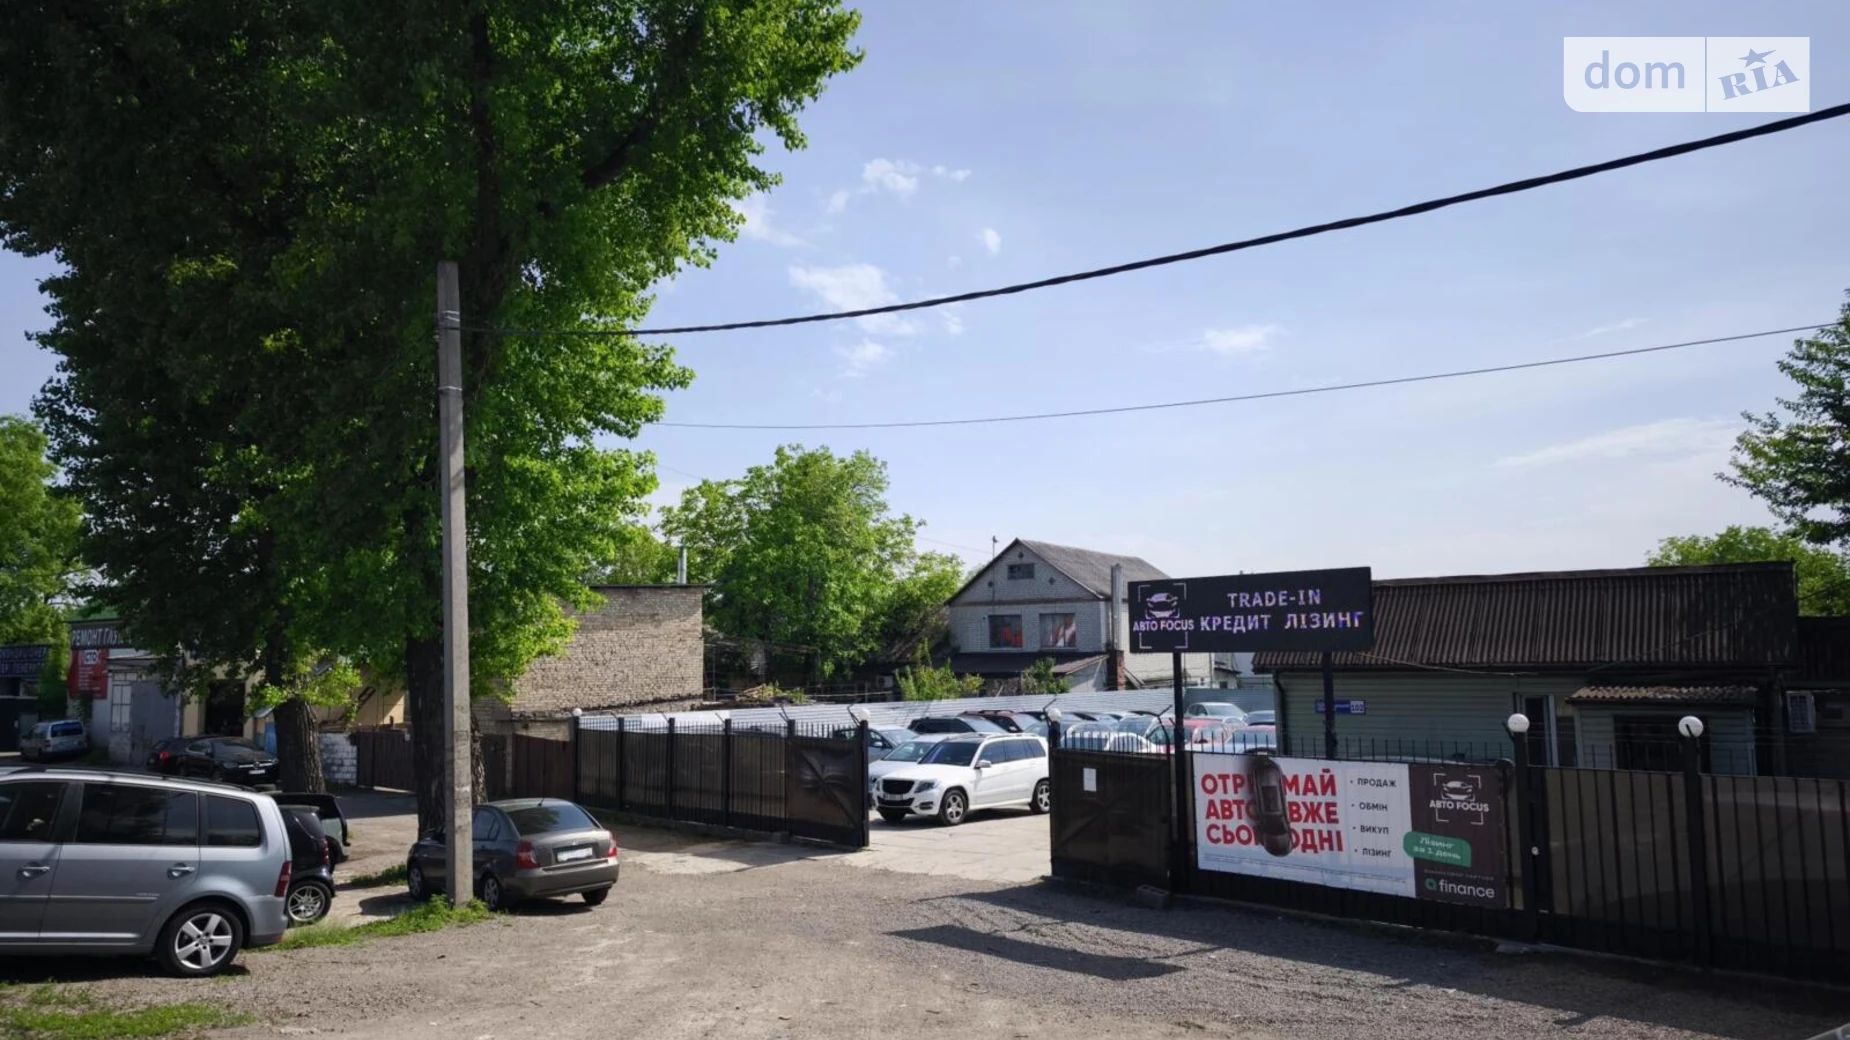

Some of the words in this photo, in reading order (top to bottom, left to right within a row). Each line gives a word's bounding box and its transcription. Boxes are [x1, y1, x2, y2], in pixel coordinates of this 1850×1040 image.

[1227, 589, 1322, 608] TRADE-IN
[1132, 620, 1158, 632] АВТО
[1160, 619, 1195, 631] FOCUS
[1199, 614, 1272, 634] КРЕДИТ
[1284, 611, 1364, 630] ЛІЗИНГ
[72, 628, 103, 647] РЕМОНТ
[1357, 777, 1397, 788] ПРОДАЖ
[1359, 801, 1388, 812] ОБМІН
[1429, 799, 1455, 810] АВТО
[1456, 801, 1490, 812] FOCUS
[1287, 801, 1340, 824] ВЖЕ
[1360, 824, 1389, 834] ВИКУП
[1362, 847, 1392, 857] ЛІЗИНГ
[1438, 879, 1496, 899] finance
